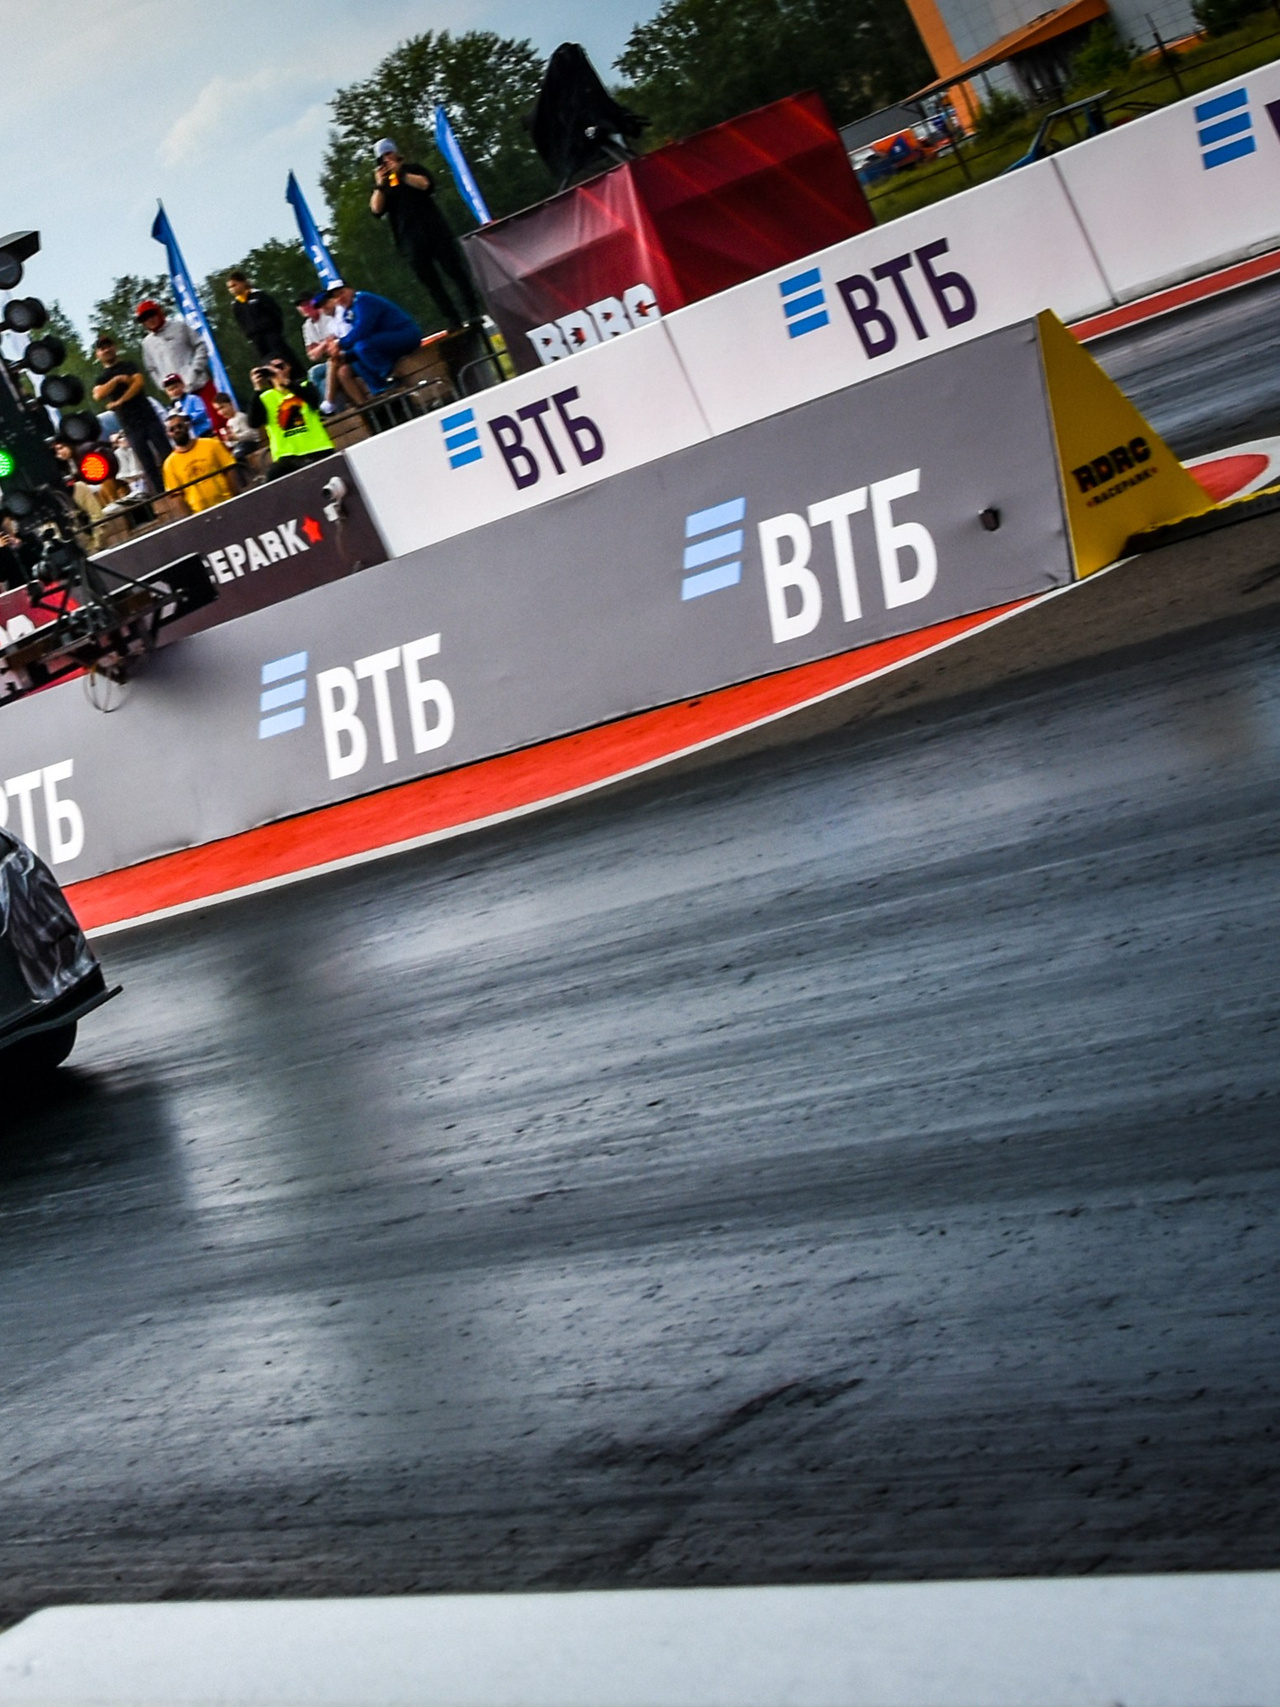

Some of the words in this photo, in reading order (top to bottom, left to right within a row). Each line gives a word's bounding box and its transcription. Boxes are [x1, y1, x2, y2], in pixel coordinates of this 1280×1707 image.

[525, 282, 662, 366] RDRC
[836, 237, 978, 360] ВТБ
[487, 385, 605, 491] ВТБ
[1070, 436, 1152, 494] RDRC
[203, 518, 310, 584] EPARK
[757, 467, 938, 645] ВТБ
[316, 632, 455, 780] ВТБ
